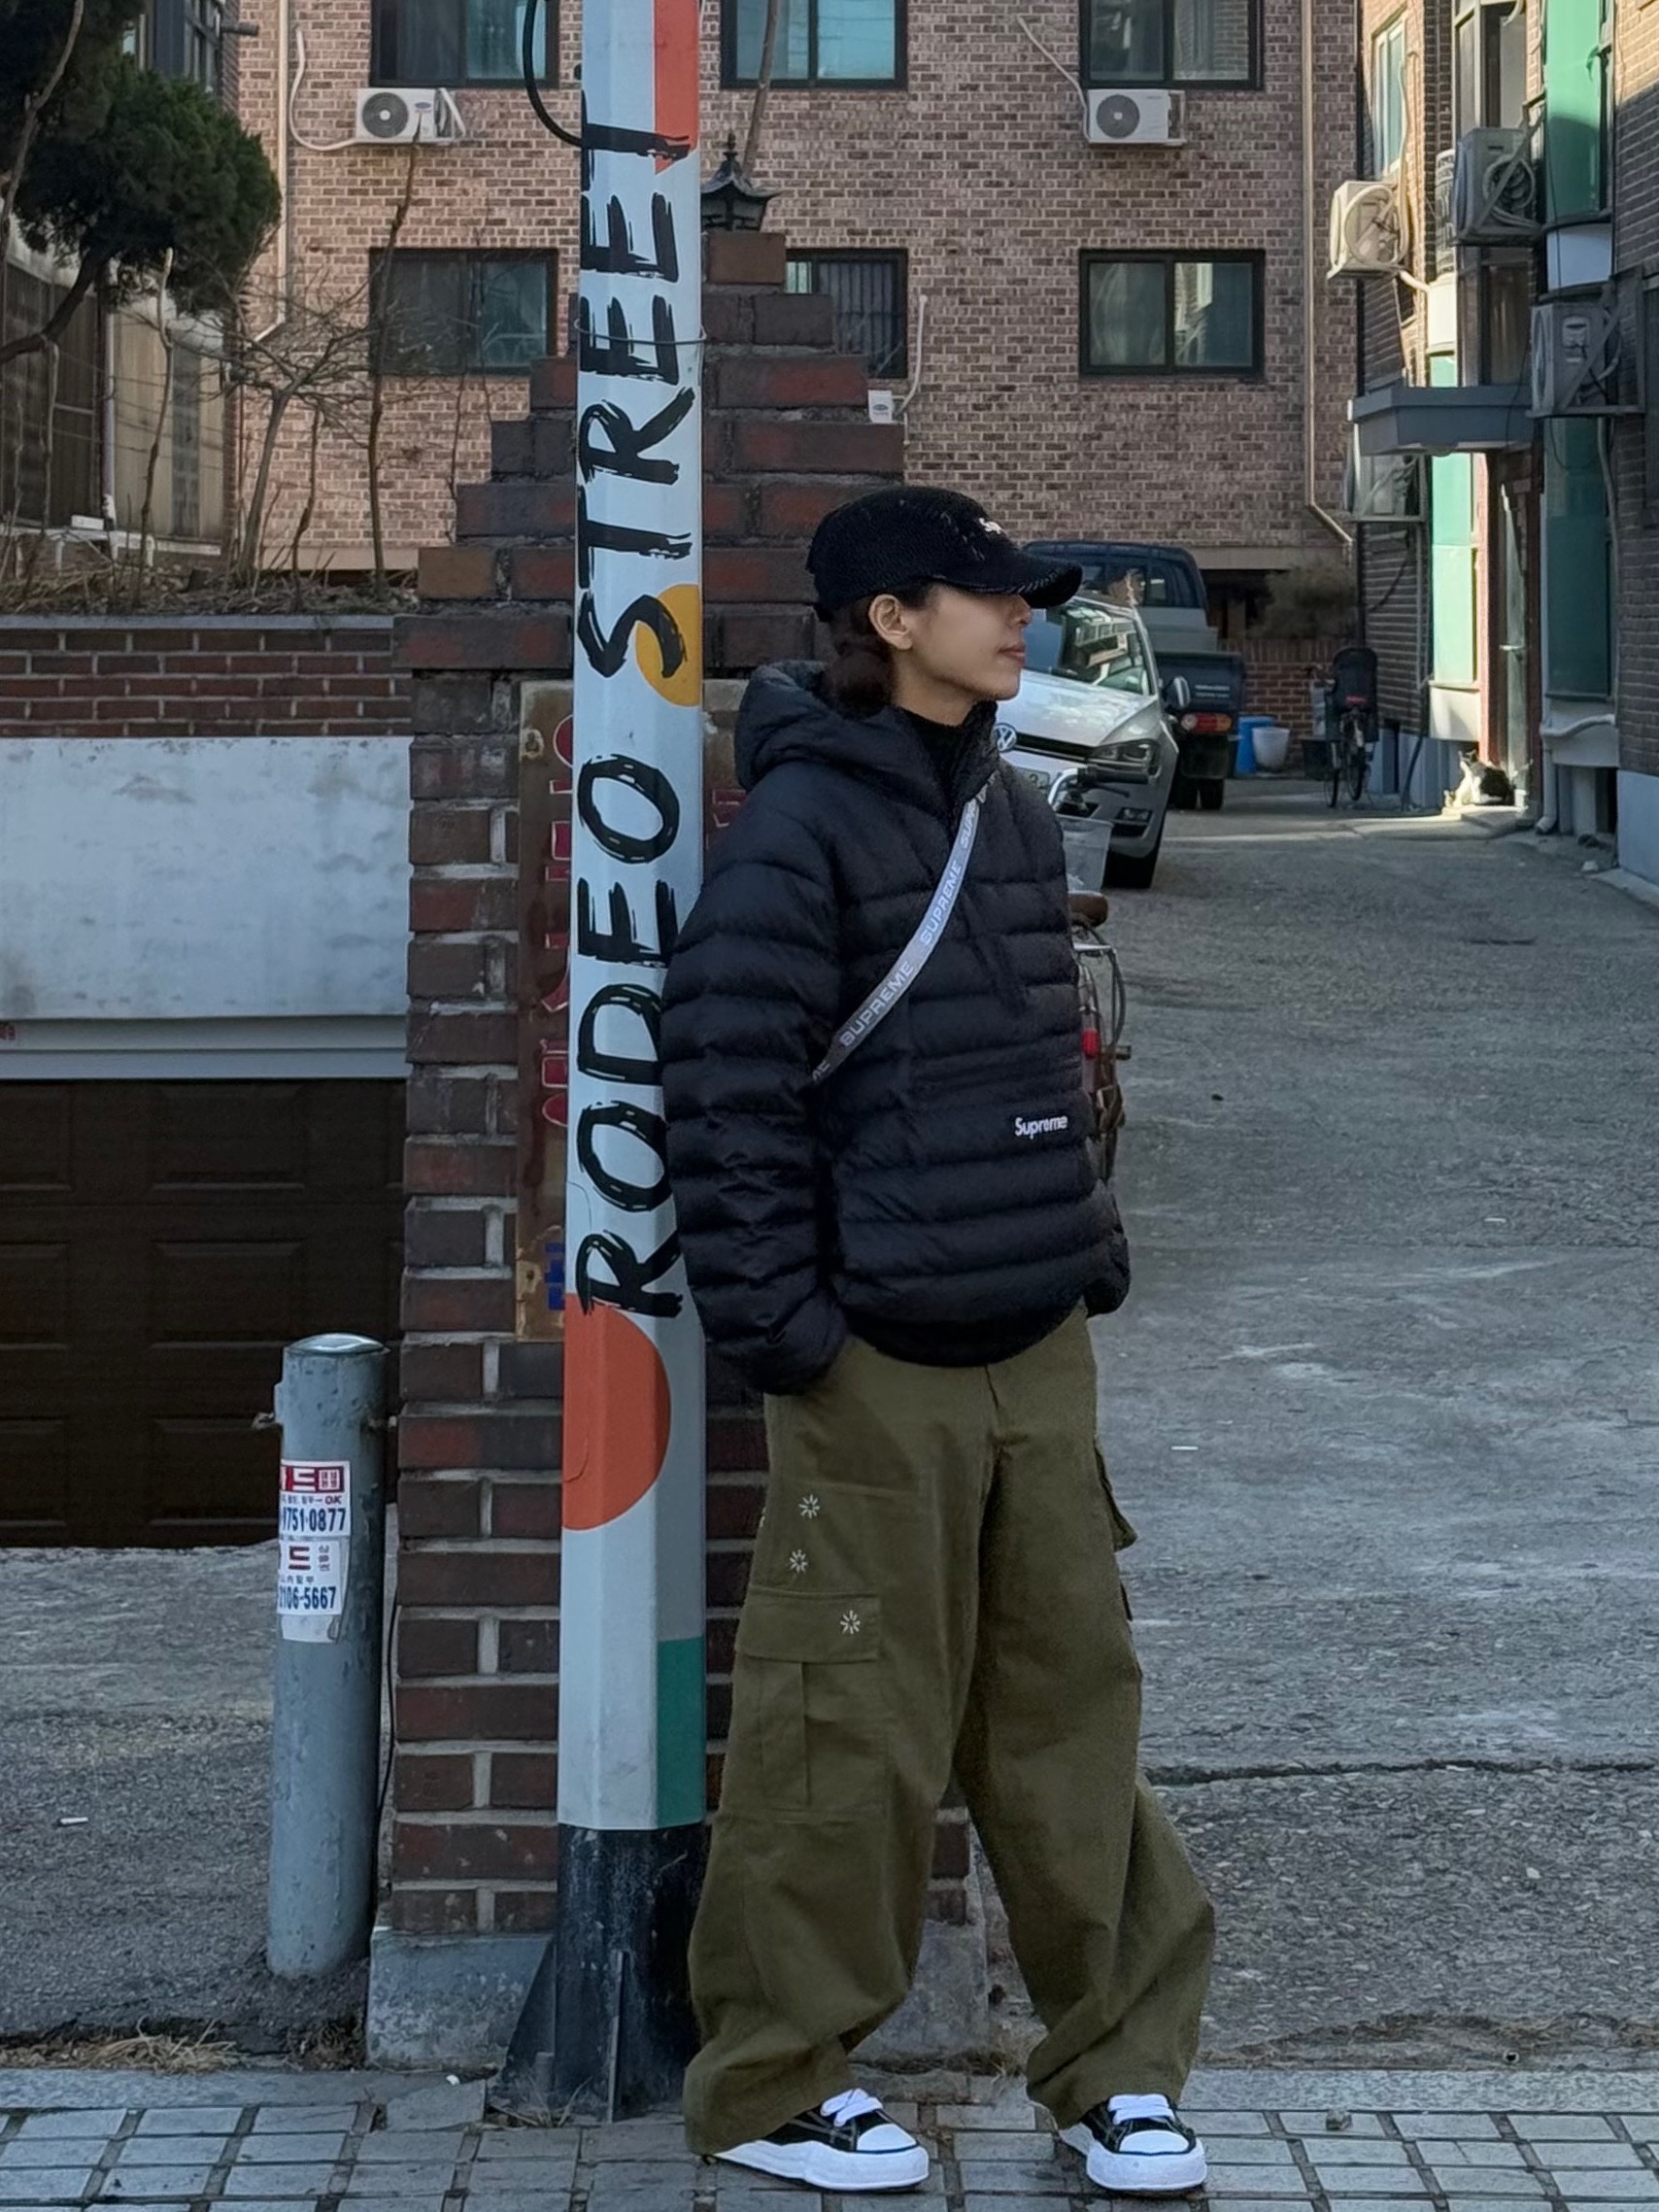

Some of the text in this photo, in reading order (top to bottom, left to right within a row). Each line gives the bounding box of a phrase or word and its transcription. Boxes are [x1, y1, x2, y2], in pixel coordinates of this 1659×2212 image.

[575, 88, 694, 1318] RODEO STREET
[919, 859, 963, 946] SUPREME
[839, 961, 914, 1046] SUPREME
[1014, 1115, 1068, 1140] Supreme
